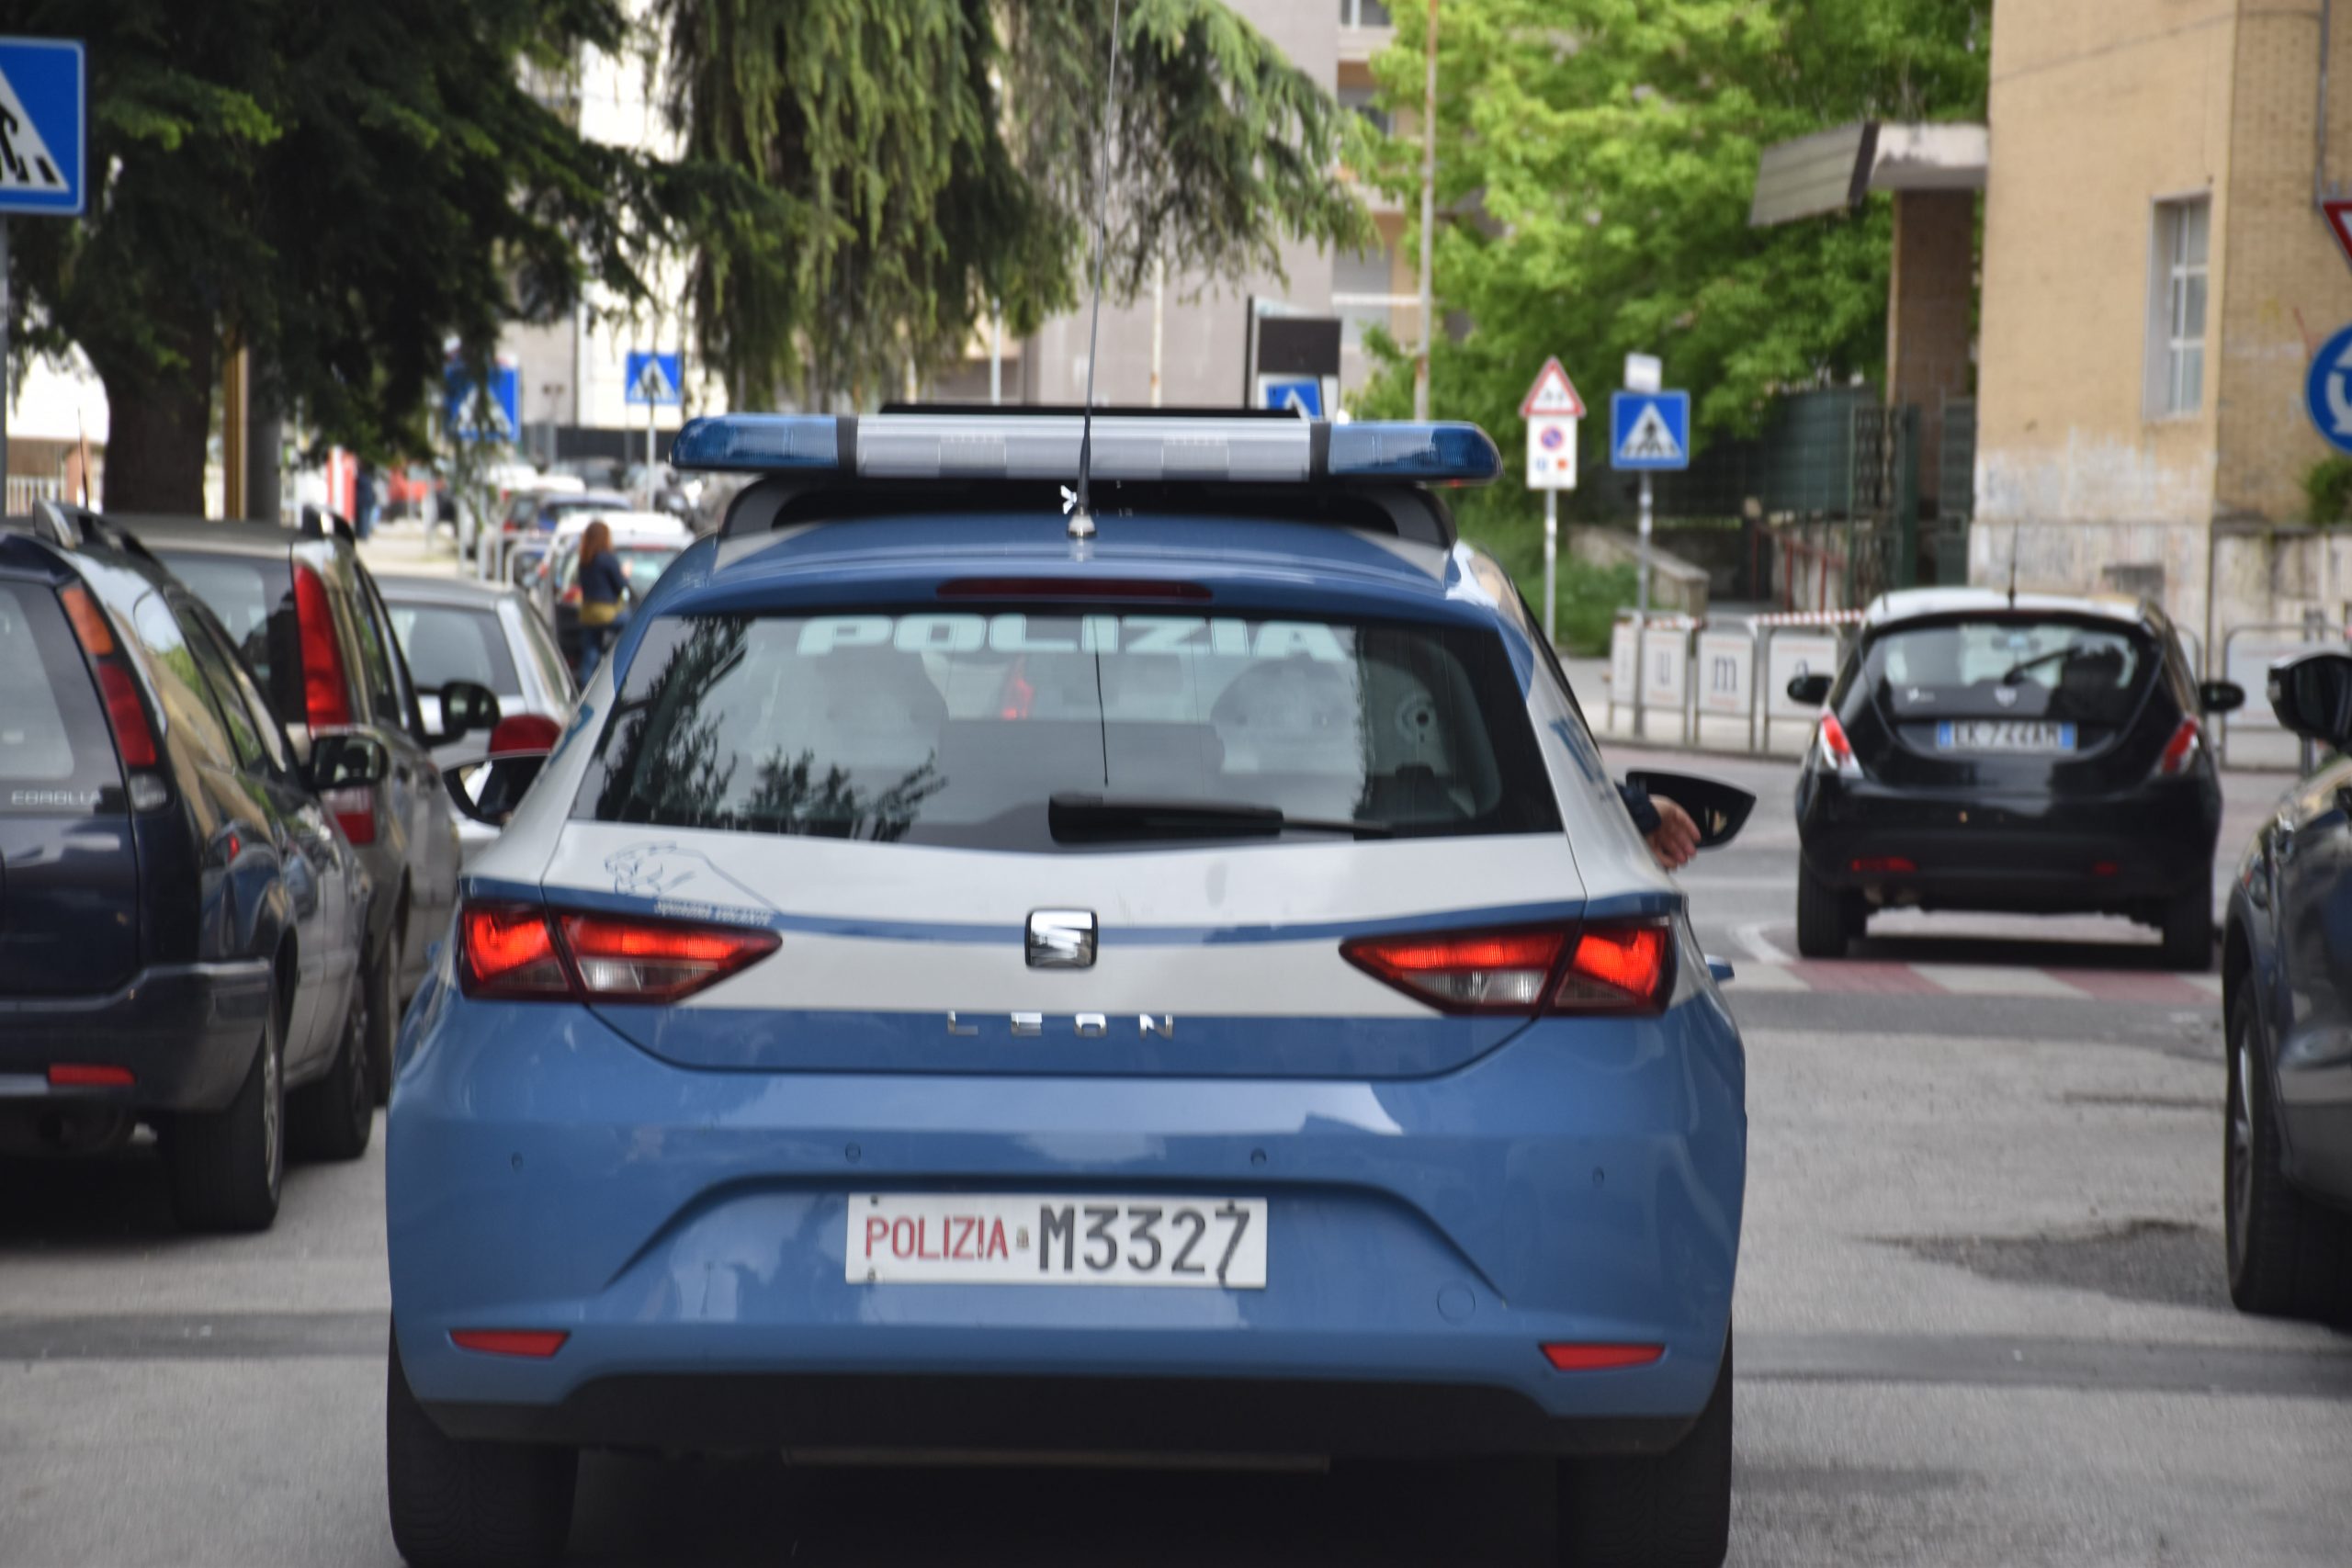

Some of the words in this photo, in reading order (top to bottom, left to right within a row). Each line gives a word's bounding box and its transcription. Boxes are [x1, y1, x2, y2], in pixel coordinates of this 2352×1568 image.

[797, 615, 1347, 660] POLIZIA
[947, 1010, 1173, 1040] LEON
[865, 1216, 1009, 1261] POLIZIA
[1039, 1204, 1250, 1274] M3327
